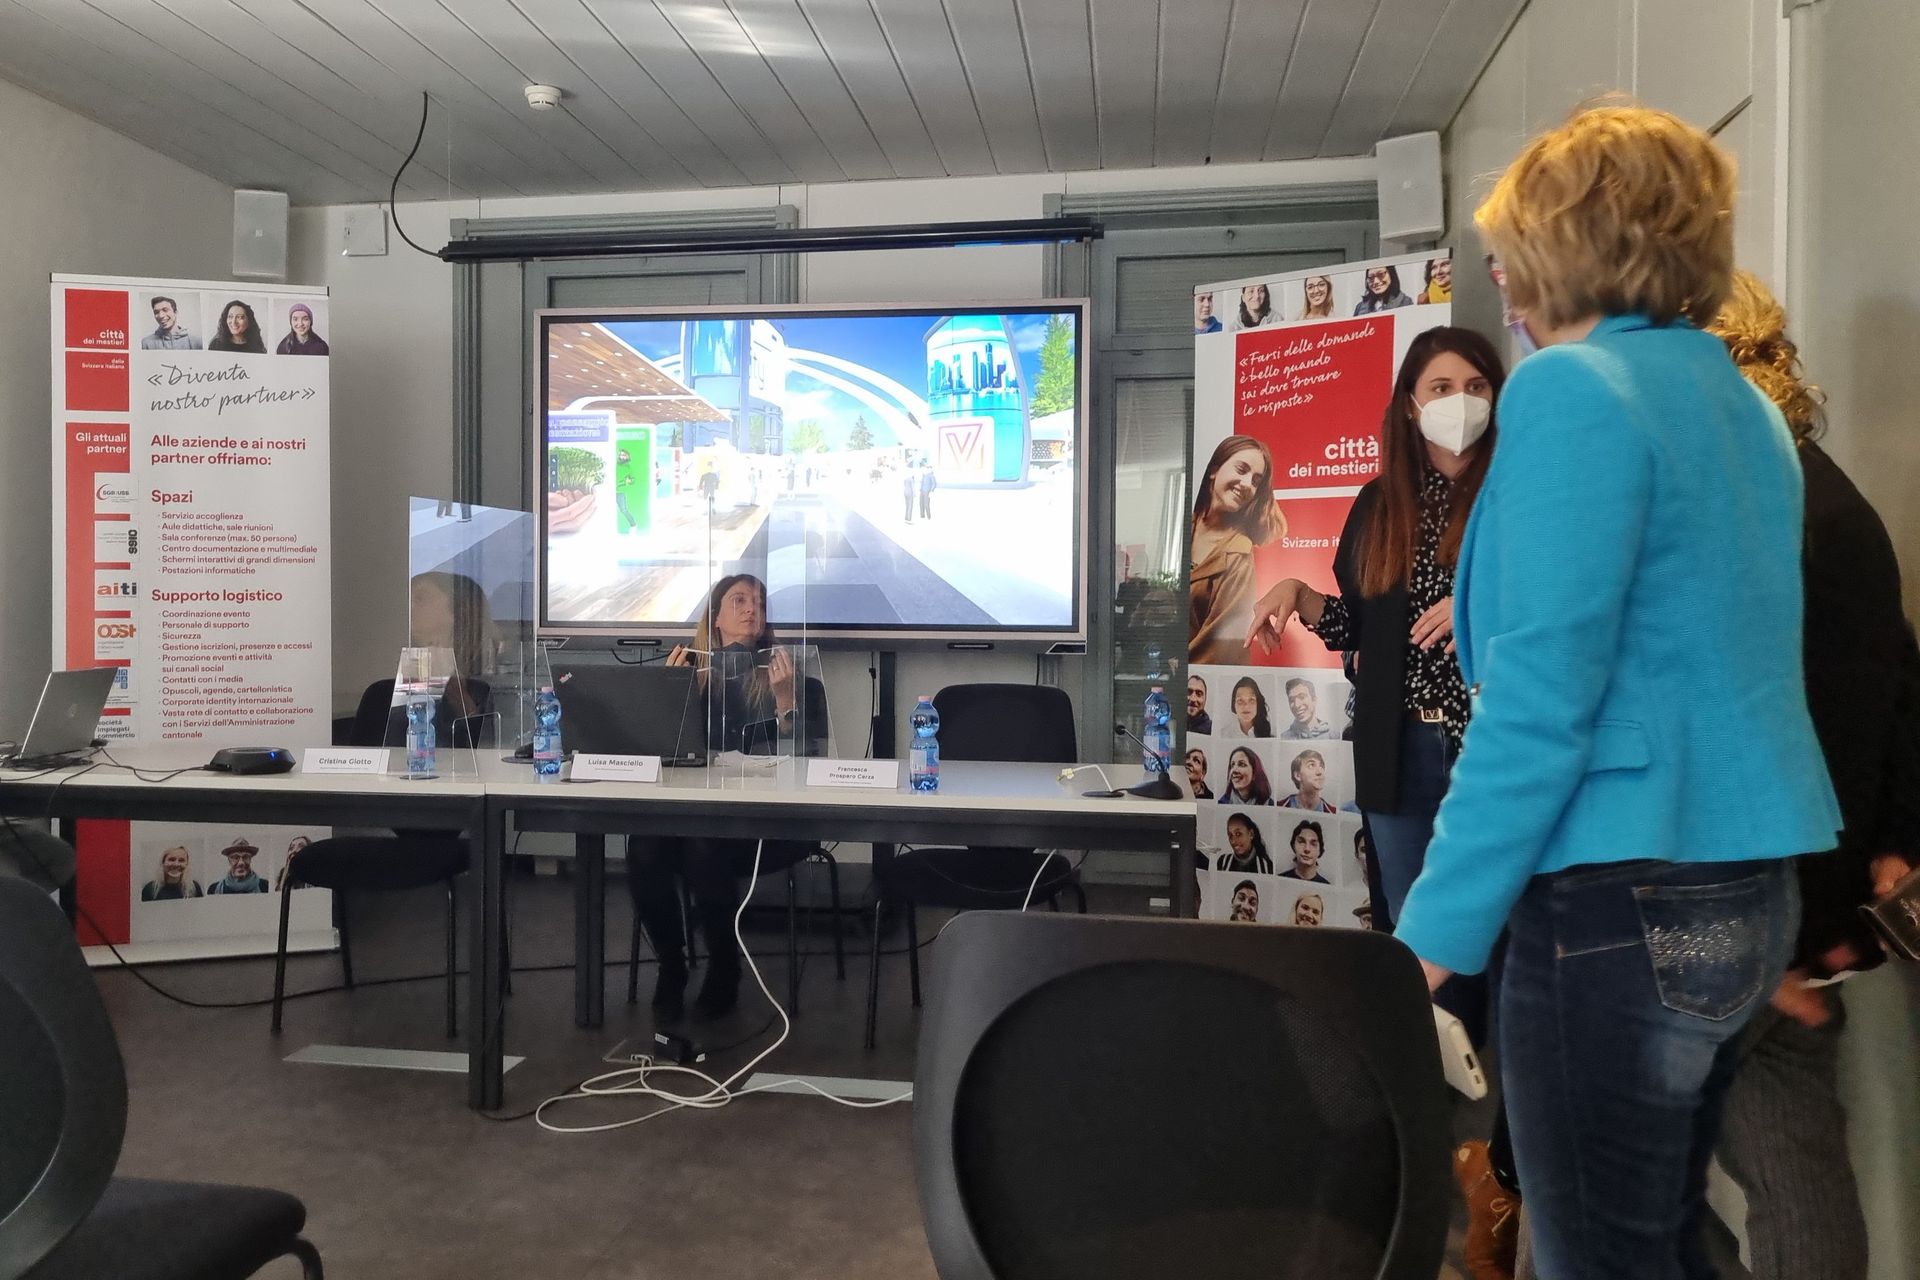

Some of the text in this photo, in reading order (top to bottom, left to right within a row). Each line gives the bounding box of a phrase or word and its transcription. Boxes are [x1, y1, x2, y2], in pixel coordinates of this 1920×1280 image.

[99, 329, 125, 339] città
[1239, 322, 1375, 367] «Farsi delle domande
[1249, 365, 1280, 383] bello
[1283, 351, 1331, 379] quando
[147, 363, 251, 386] «Diventa
[1241, 369, 1342, 400] sai dove trovare
[151, 386, 316, 415] nostro partner»
[1243, 393, 1314, 417] le risposte»
[75, 432, 127, 442] Gli attuali
[151, 434, 306, 450] Alle aziende e ai nostri
[87, 445, 127, 454] partner
[1324, 435, 1379, 460] città
[151, 452, 272, 465] partner offriamo:
[1289, 458, 1379, 477] dei mestieri
[151, 489, 193, 505] Spazi
[196, 513, 243, 521] accoglienza
[182, 523, 225, 531] didattiche,
[227, 523, 243, 531] sale
[228, 534, 249, 542] (max.
[263, 534, 297, 543] persone)
[1282, 537, 1329, 548] Svizzera
[246, 556, 271, 565] grandi
[162, 566, 203, 574] Postazioni
[97, 582, 137, 595] aiti
[152, 589, 283, 604] Supporto logistico
[213, 622, 250, 630] supporto
[201, 642, 239, 651] iscrizioni,
[162, 685, 293, 696] Opuscoli, agende, cartellonistica
[162, 696, 294, 707] Corporate identity internazionale
[162, 709, 185, 717] Vasta
[204, 708, 213, 716] di
[213, 708, 248, 716] contatto
[255, 706, 314, 715] collaborazione
[162, 731, 203, 739] cantonale
